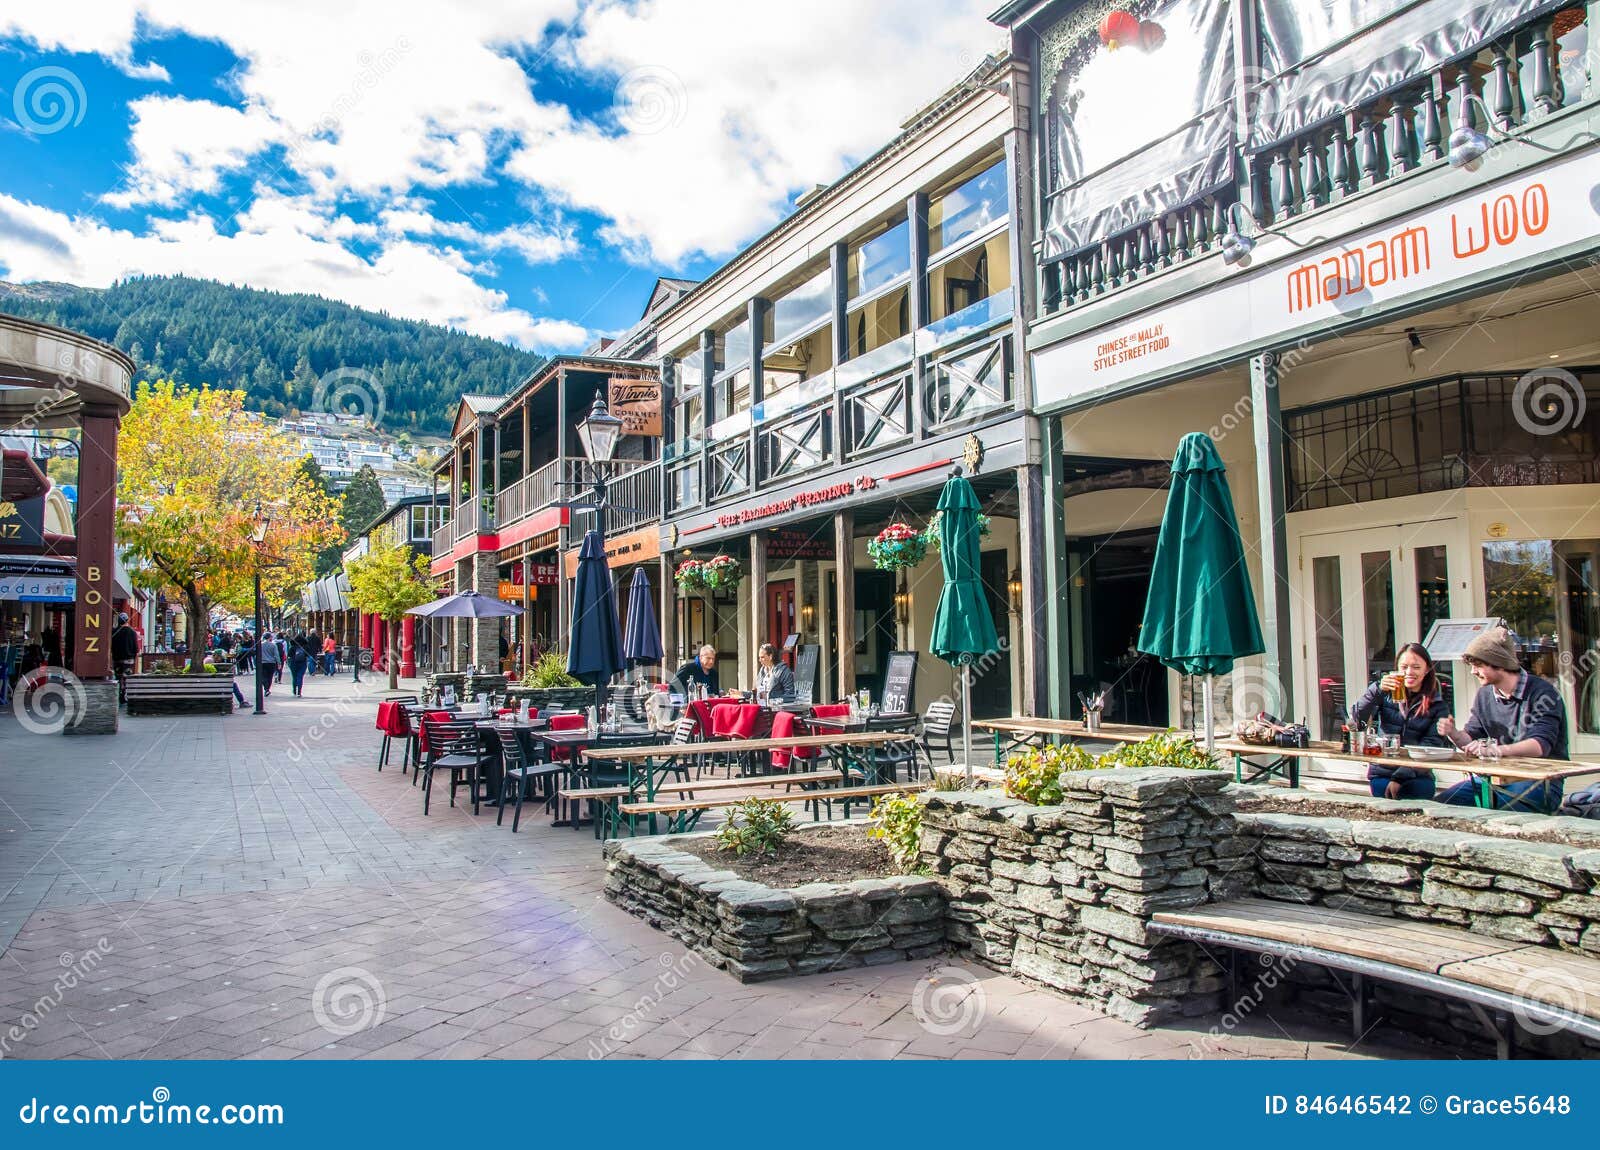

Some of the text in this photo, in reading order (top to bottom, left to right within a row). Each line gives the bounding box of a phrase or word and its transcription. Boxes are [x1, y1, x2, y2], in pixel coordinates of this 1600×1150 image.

[1451, 183, 1550, 259] WOO
[1093, 336, 1170, 372] STYLE STREET FOOD
[1097, 336, 1128, 356] CHINESE
[1138, 323, 1164, 342] MALAY
[611, 384, 659, 404] Winnies
[717, 514, 739, 527] THE
[739, 501, 792, 523] BALLARAT
[795, 482, 851, 507] TRADING
[767, 539, 828, 548] ALLARAT
[767, 548, 815, 557] RADING
[85, 566, 102, 653] BONZ
[884, 694, 905, 712] $15
